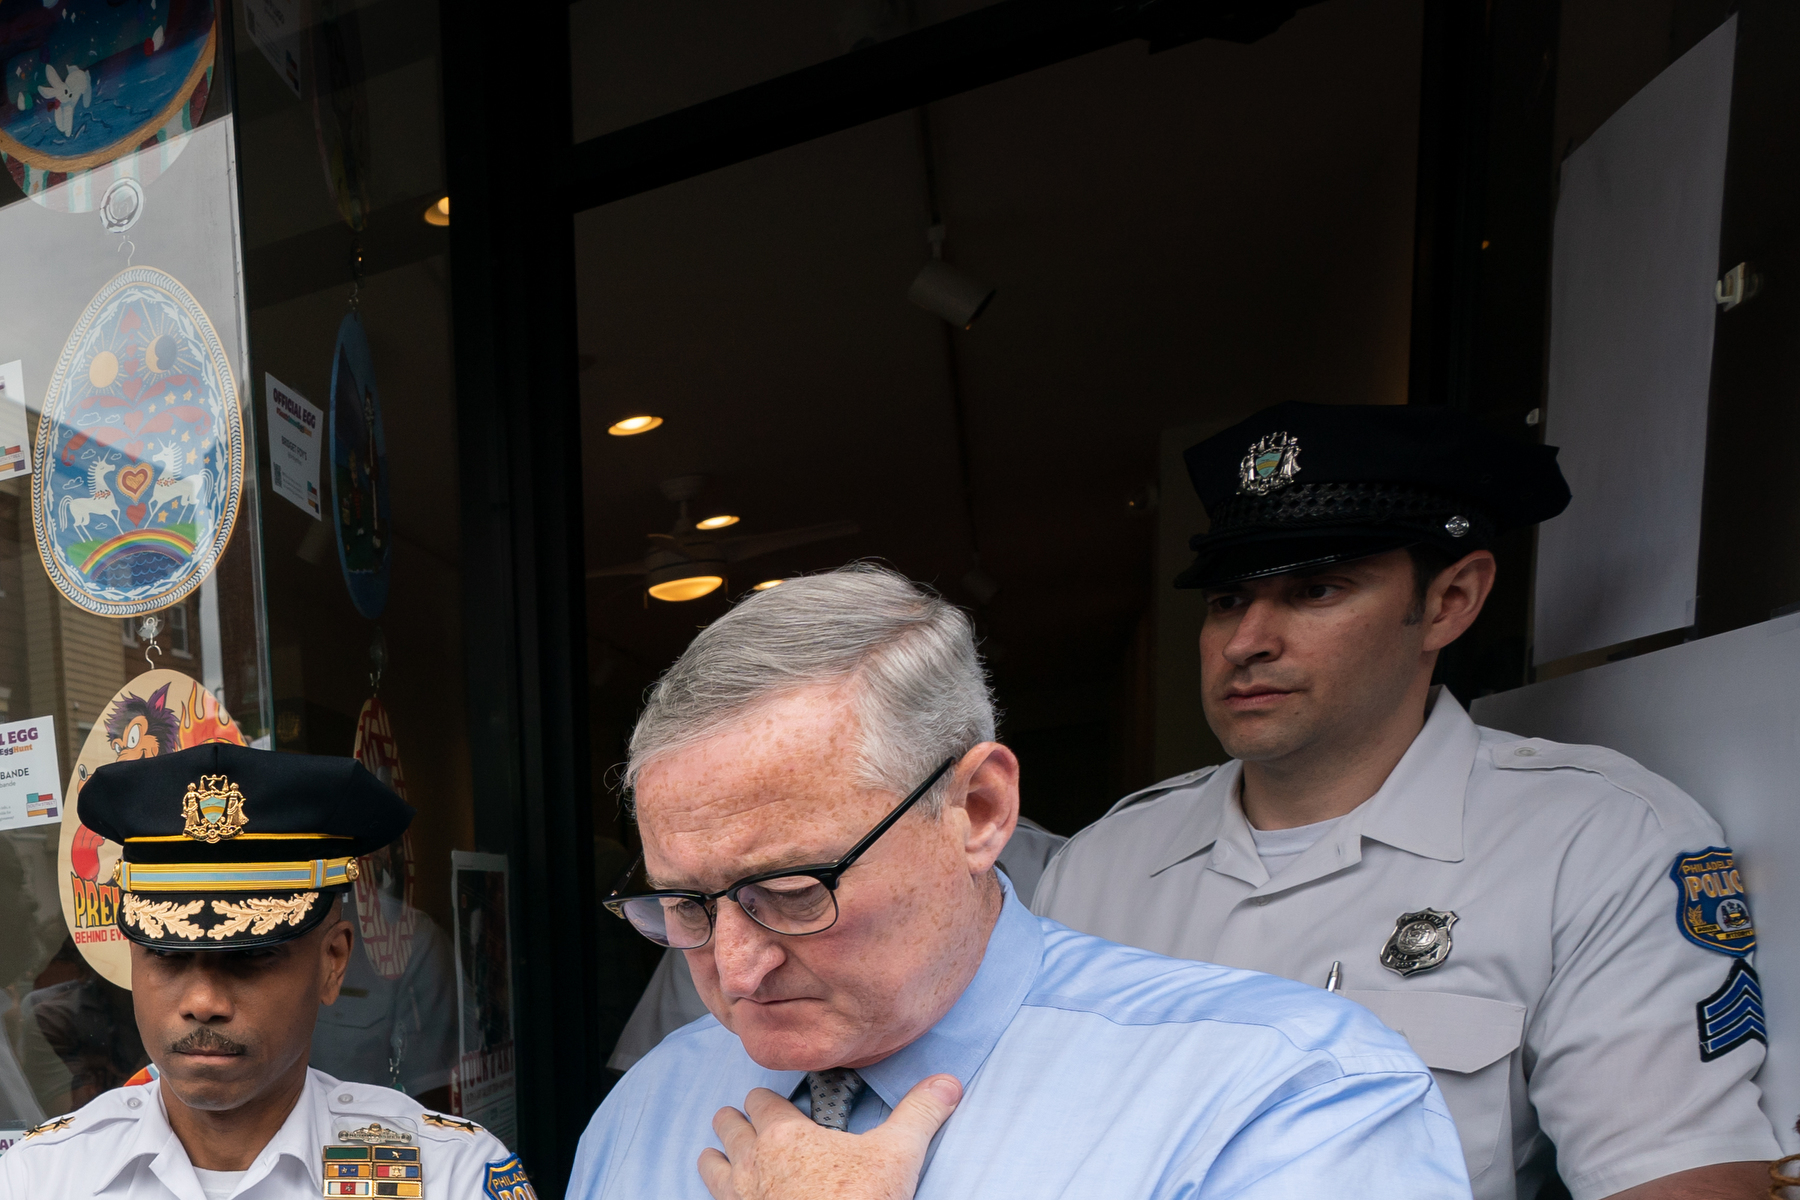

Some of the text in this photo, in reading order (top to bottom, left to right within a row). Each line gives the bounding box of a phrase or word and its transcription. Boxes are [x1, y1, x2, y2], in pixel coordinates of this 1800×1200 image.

[273, 388, 316, 429] OFFICIAL EGG
[7, 727, 39, 744] EGG
[0, 767, 30, 780] BANDE
[75, 929, 128, 944] BEHIND EV
